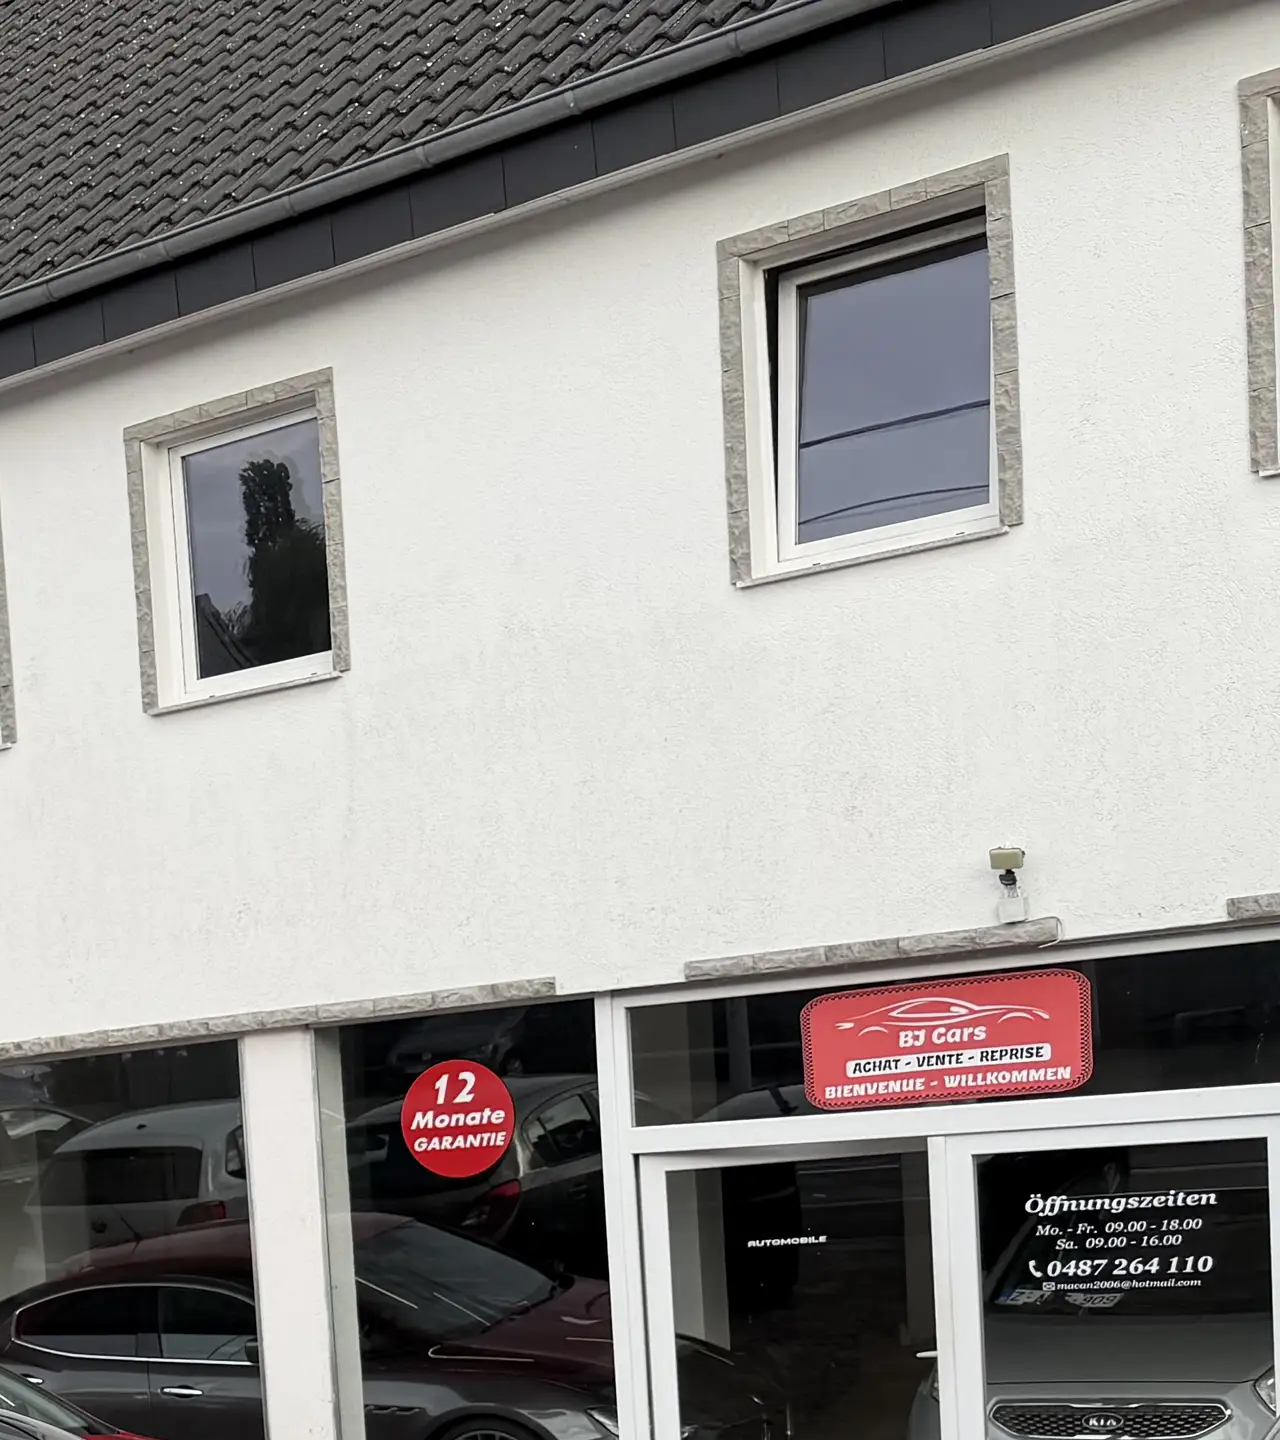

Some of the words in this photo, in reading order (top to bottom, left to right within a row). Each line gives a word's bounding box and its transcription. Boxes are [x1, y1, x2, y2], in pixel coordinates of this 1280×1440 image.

[898, 1030, 925, 1048] BJ
[931, 1025, 987, 1045] Cars
[852, 1059, 901, 1075] ACHAT
[916, 1052, 964, 1069] VENTE
[980, 1046, 1044, 1063] REPRISE
[434, 1071, 476, 1105] 12
[825, 1078, 925, 1099] BIENVENUE
[943, 1066, 1072, 1089] WILLKOMMEN
[410, 1107, 506, 1130] Monate
[413, 1131, 507, 1152] GARANTIE
[1024, 1189, 1218, 1217] Öffnungszeiten
[1035, 1224, 1064, 1236] Mo.
[1076, 1223, 1098, 1235] Fr.
[1105, 1220, 1147, 1234] 09.00
[1161, 1218, 1203, 1231] 18.00
[1055, 1238, 1079, 1250] Sa.
[1085, 1236, 1127, 1249] 09.00
[1141, 1234, 1183, 1247] 16.00
[1046, 1258, 1108, 1277] 0487
[1112, 1257, 1160, 1276] 264
[1166, 1255, 1214, 1274] 110
[1056, 1278, 1202, 1291] macan2006@hotmail.com
[1089, 1417, 1117, 1426] KIA
